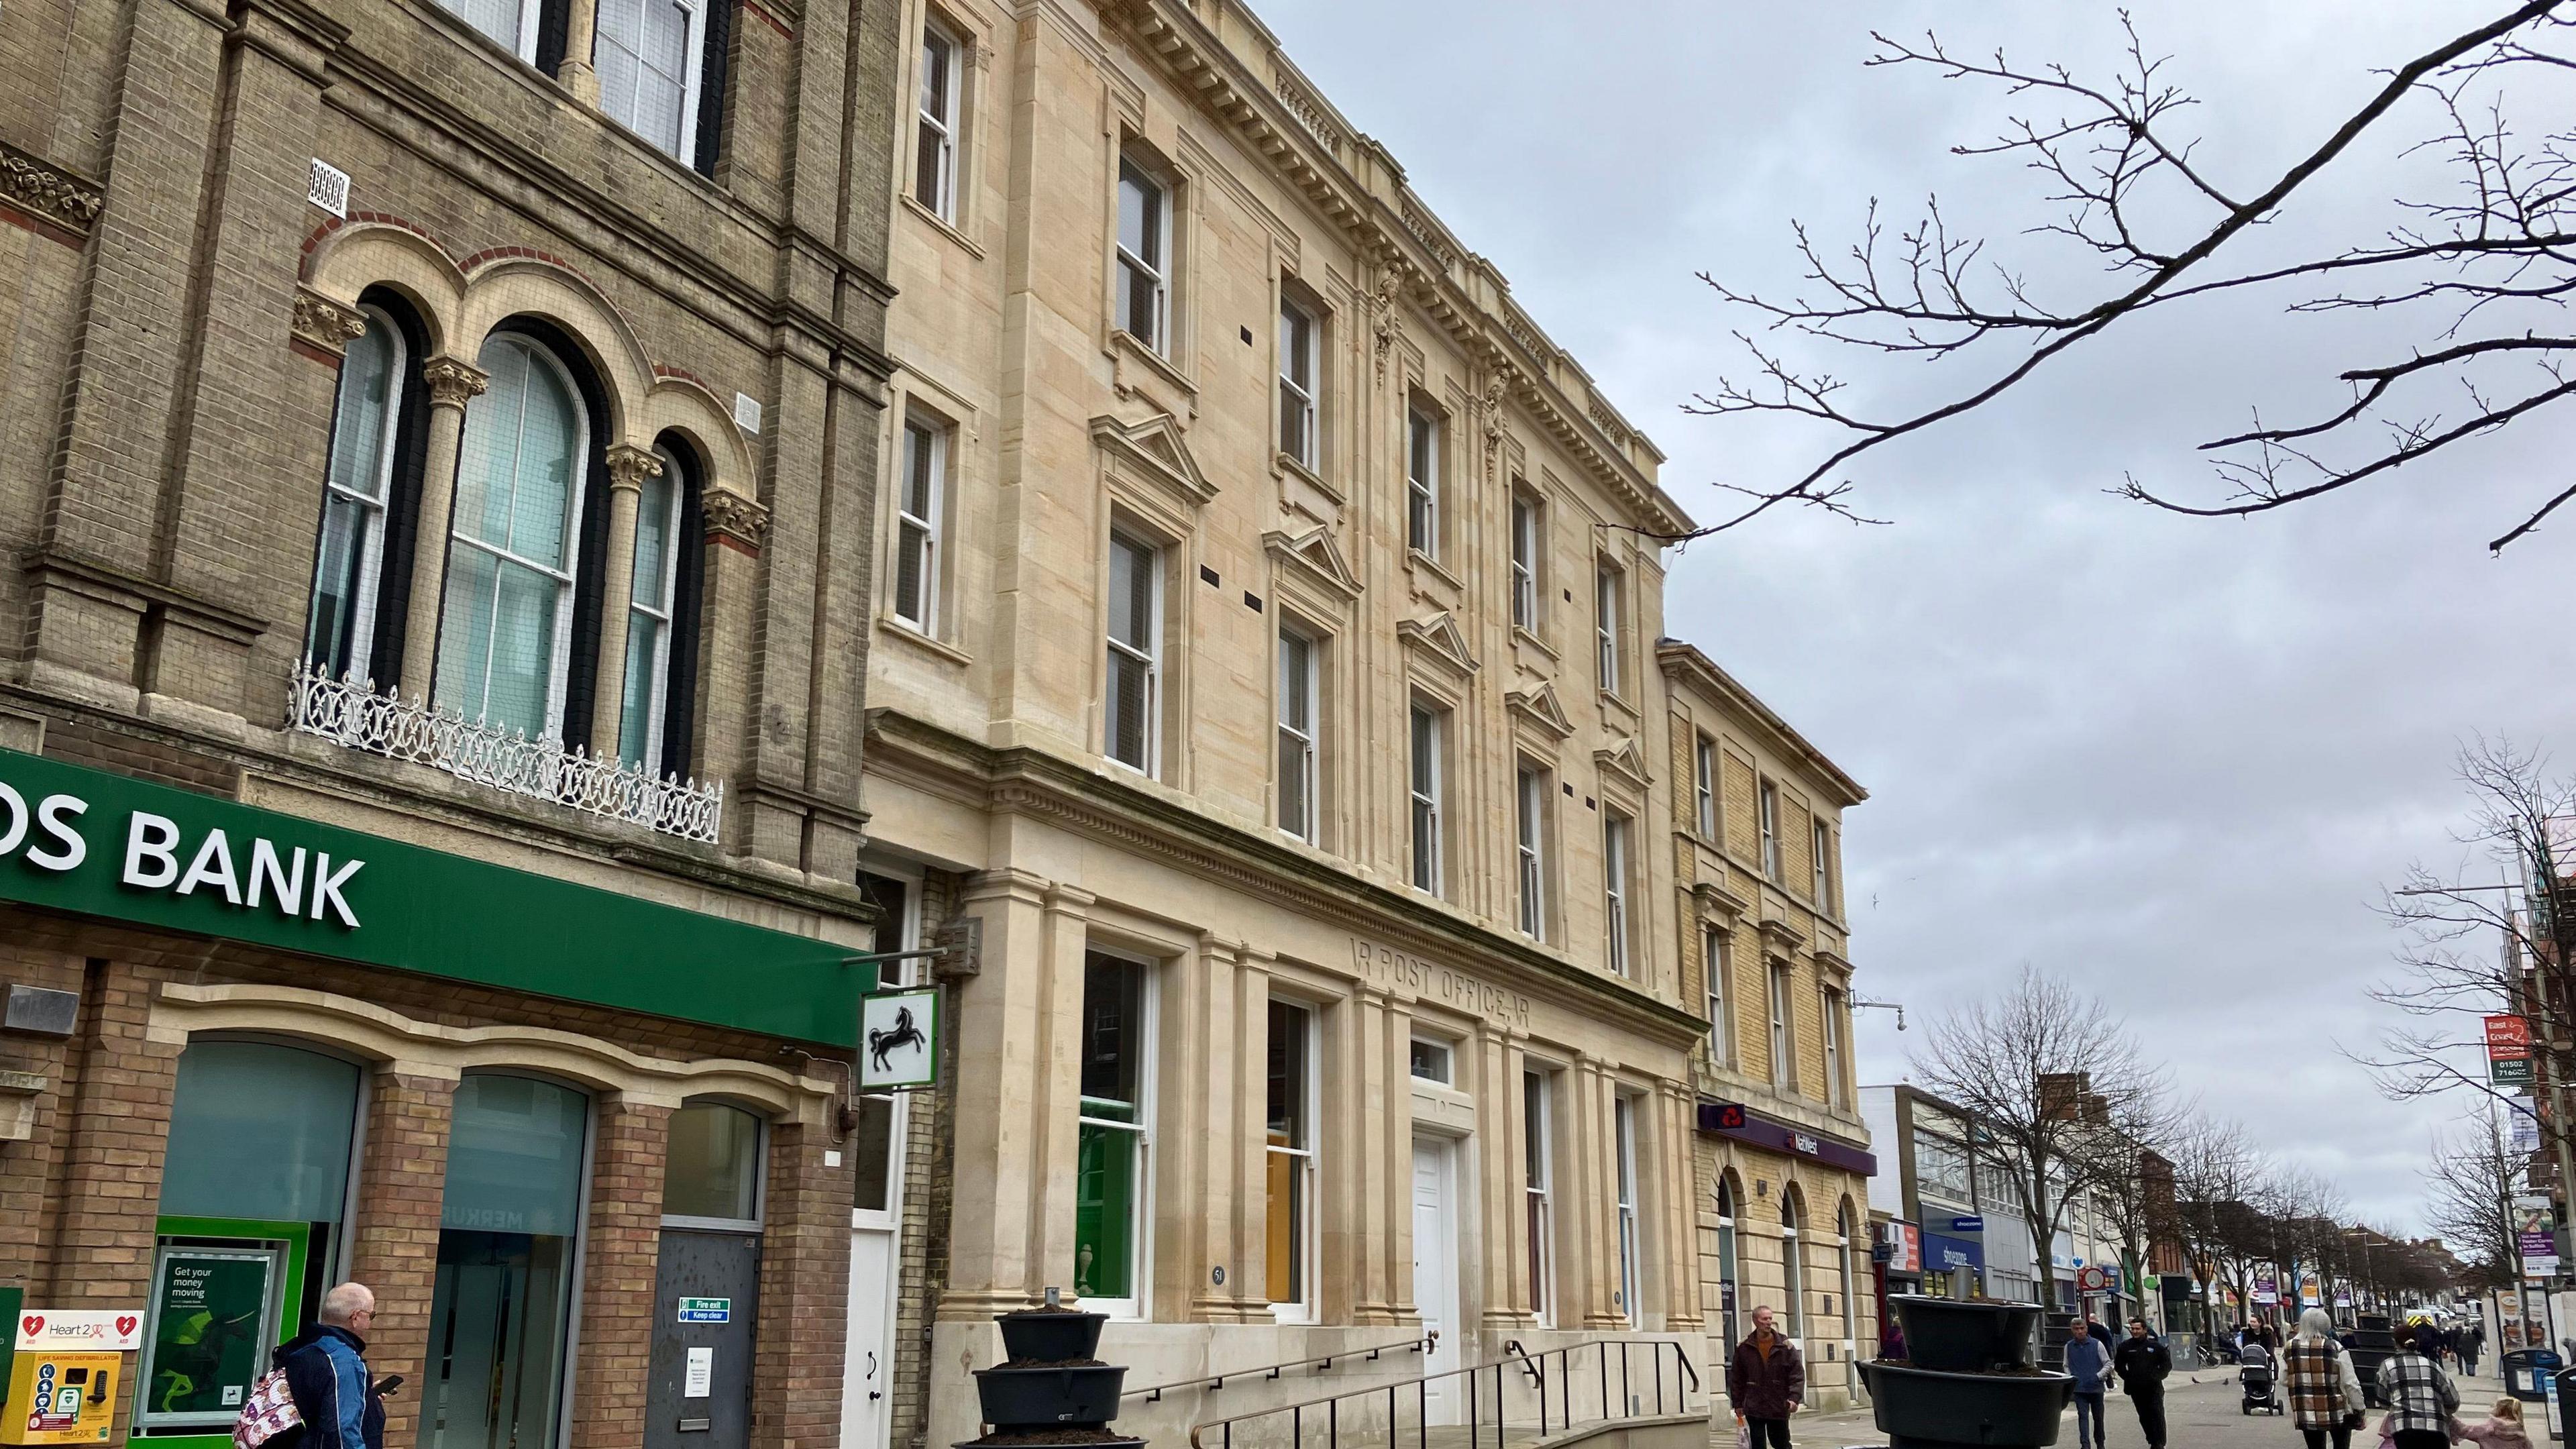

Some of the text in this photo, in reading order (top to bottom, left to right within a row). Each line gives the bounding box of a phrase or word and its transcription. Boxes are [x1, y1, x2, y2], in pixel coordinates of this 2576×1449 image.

[123, 810, 366, 928] BANK
[1380, 949, 1432, 995] POST
[2488, 1022, 2507, 1030] East
[1795, 1132, 1818, 1155] NatWest
[1943, 1245, 1968, 1265] shoezone
[174, 1267, 212, 1279] Get your
[1214, 1269, 1222, 1282] 51
[173, 1279, 203, 1289] money
[172, 1288, 205, 1299] moving
[696, 1301, 708, 1309] Fire
[693, 1311, 708, 1320] Keep
[49, 1324, 91, 1335] Heart 2
